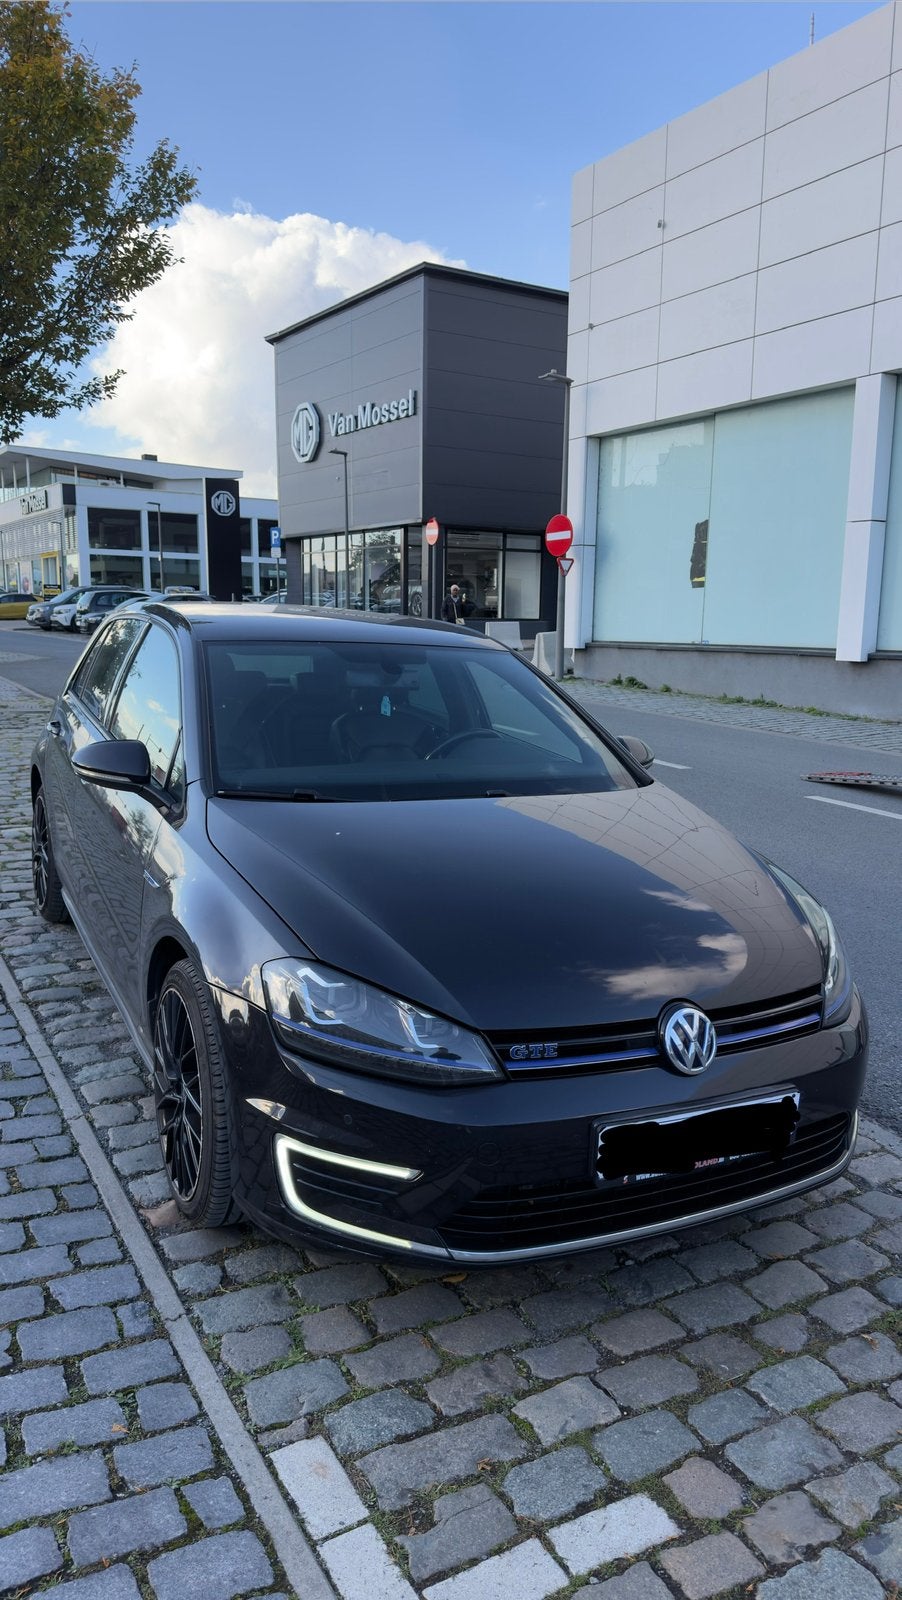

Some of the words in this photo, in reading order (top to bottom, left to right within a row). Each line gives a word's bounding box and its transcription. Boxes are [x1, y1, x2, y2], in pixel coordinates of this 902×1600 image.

[328, 412, 354, 437] Van
[357, 389, 415, 430] Mossel
[293, 407, 316, 459] MG
[213, 492, 234, 514] MG
[271, 530, 279, 545] P
[509, 1043, 558, 1060] GTE
